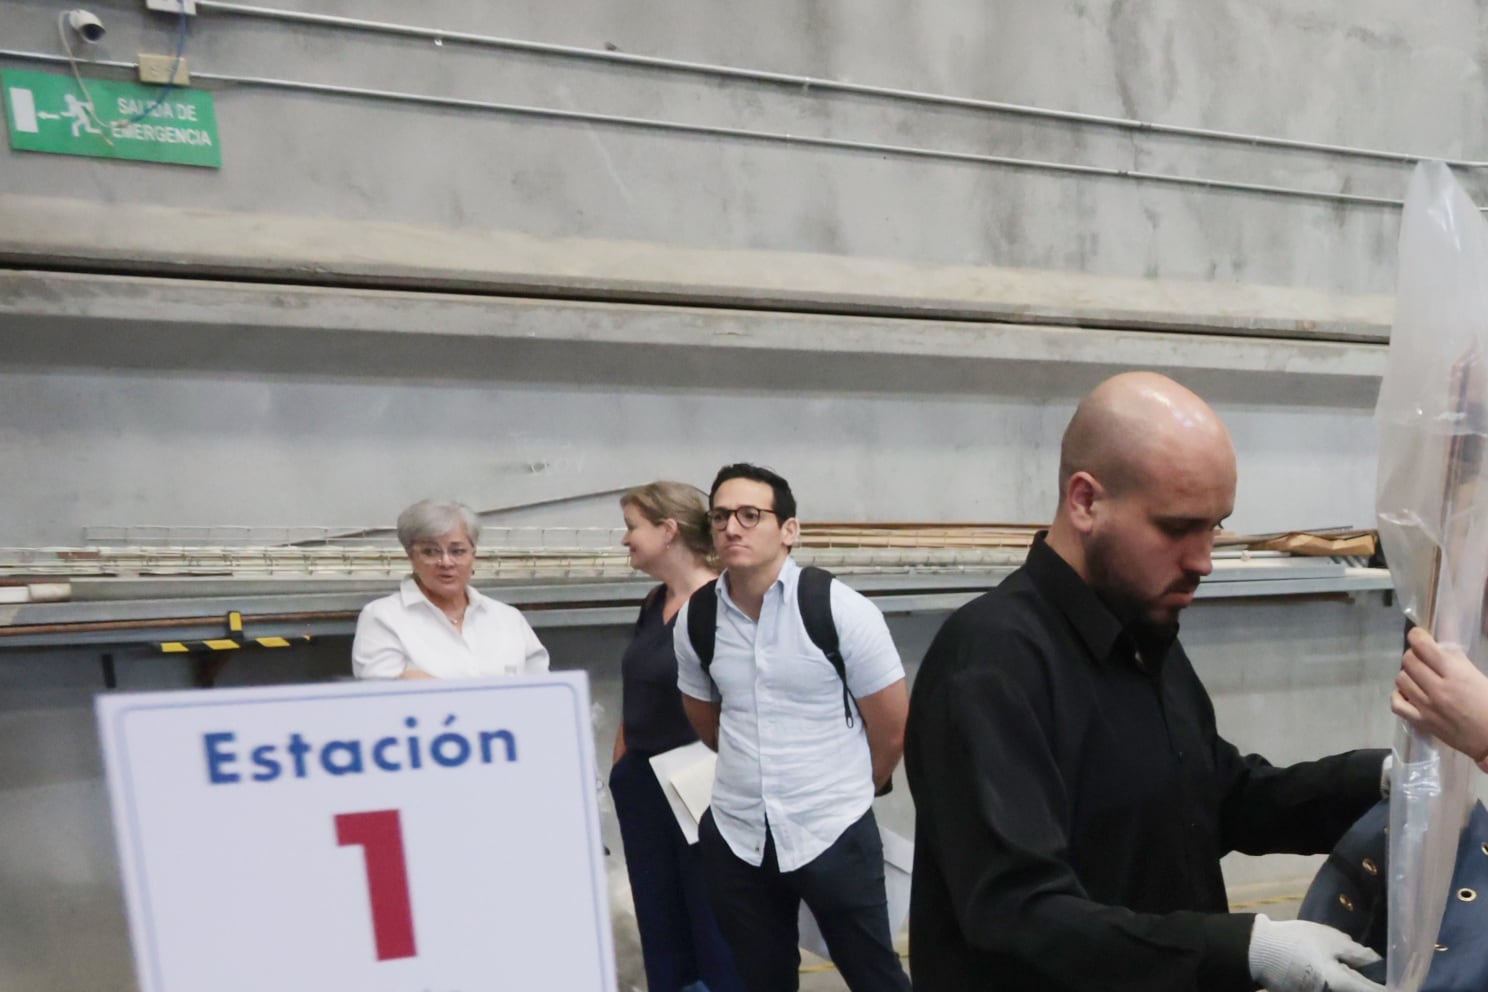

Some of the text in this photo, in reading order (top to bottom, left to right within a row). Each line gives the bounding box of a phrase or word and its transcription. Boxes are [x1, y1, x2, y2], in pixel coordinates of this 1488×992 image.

[111, 121, 213, 147] EMERGENCIA
[176, 103, 198, 122] DE
[202, 715, 519, 786] Estación
[333, 808, 418, 962] 1
